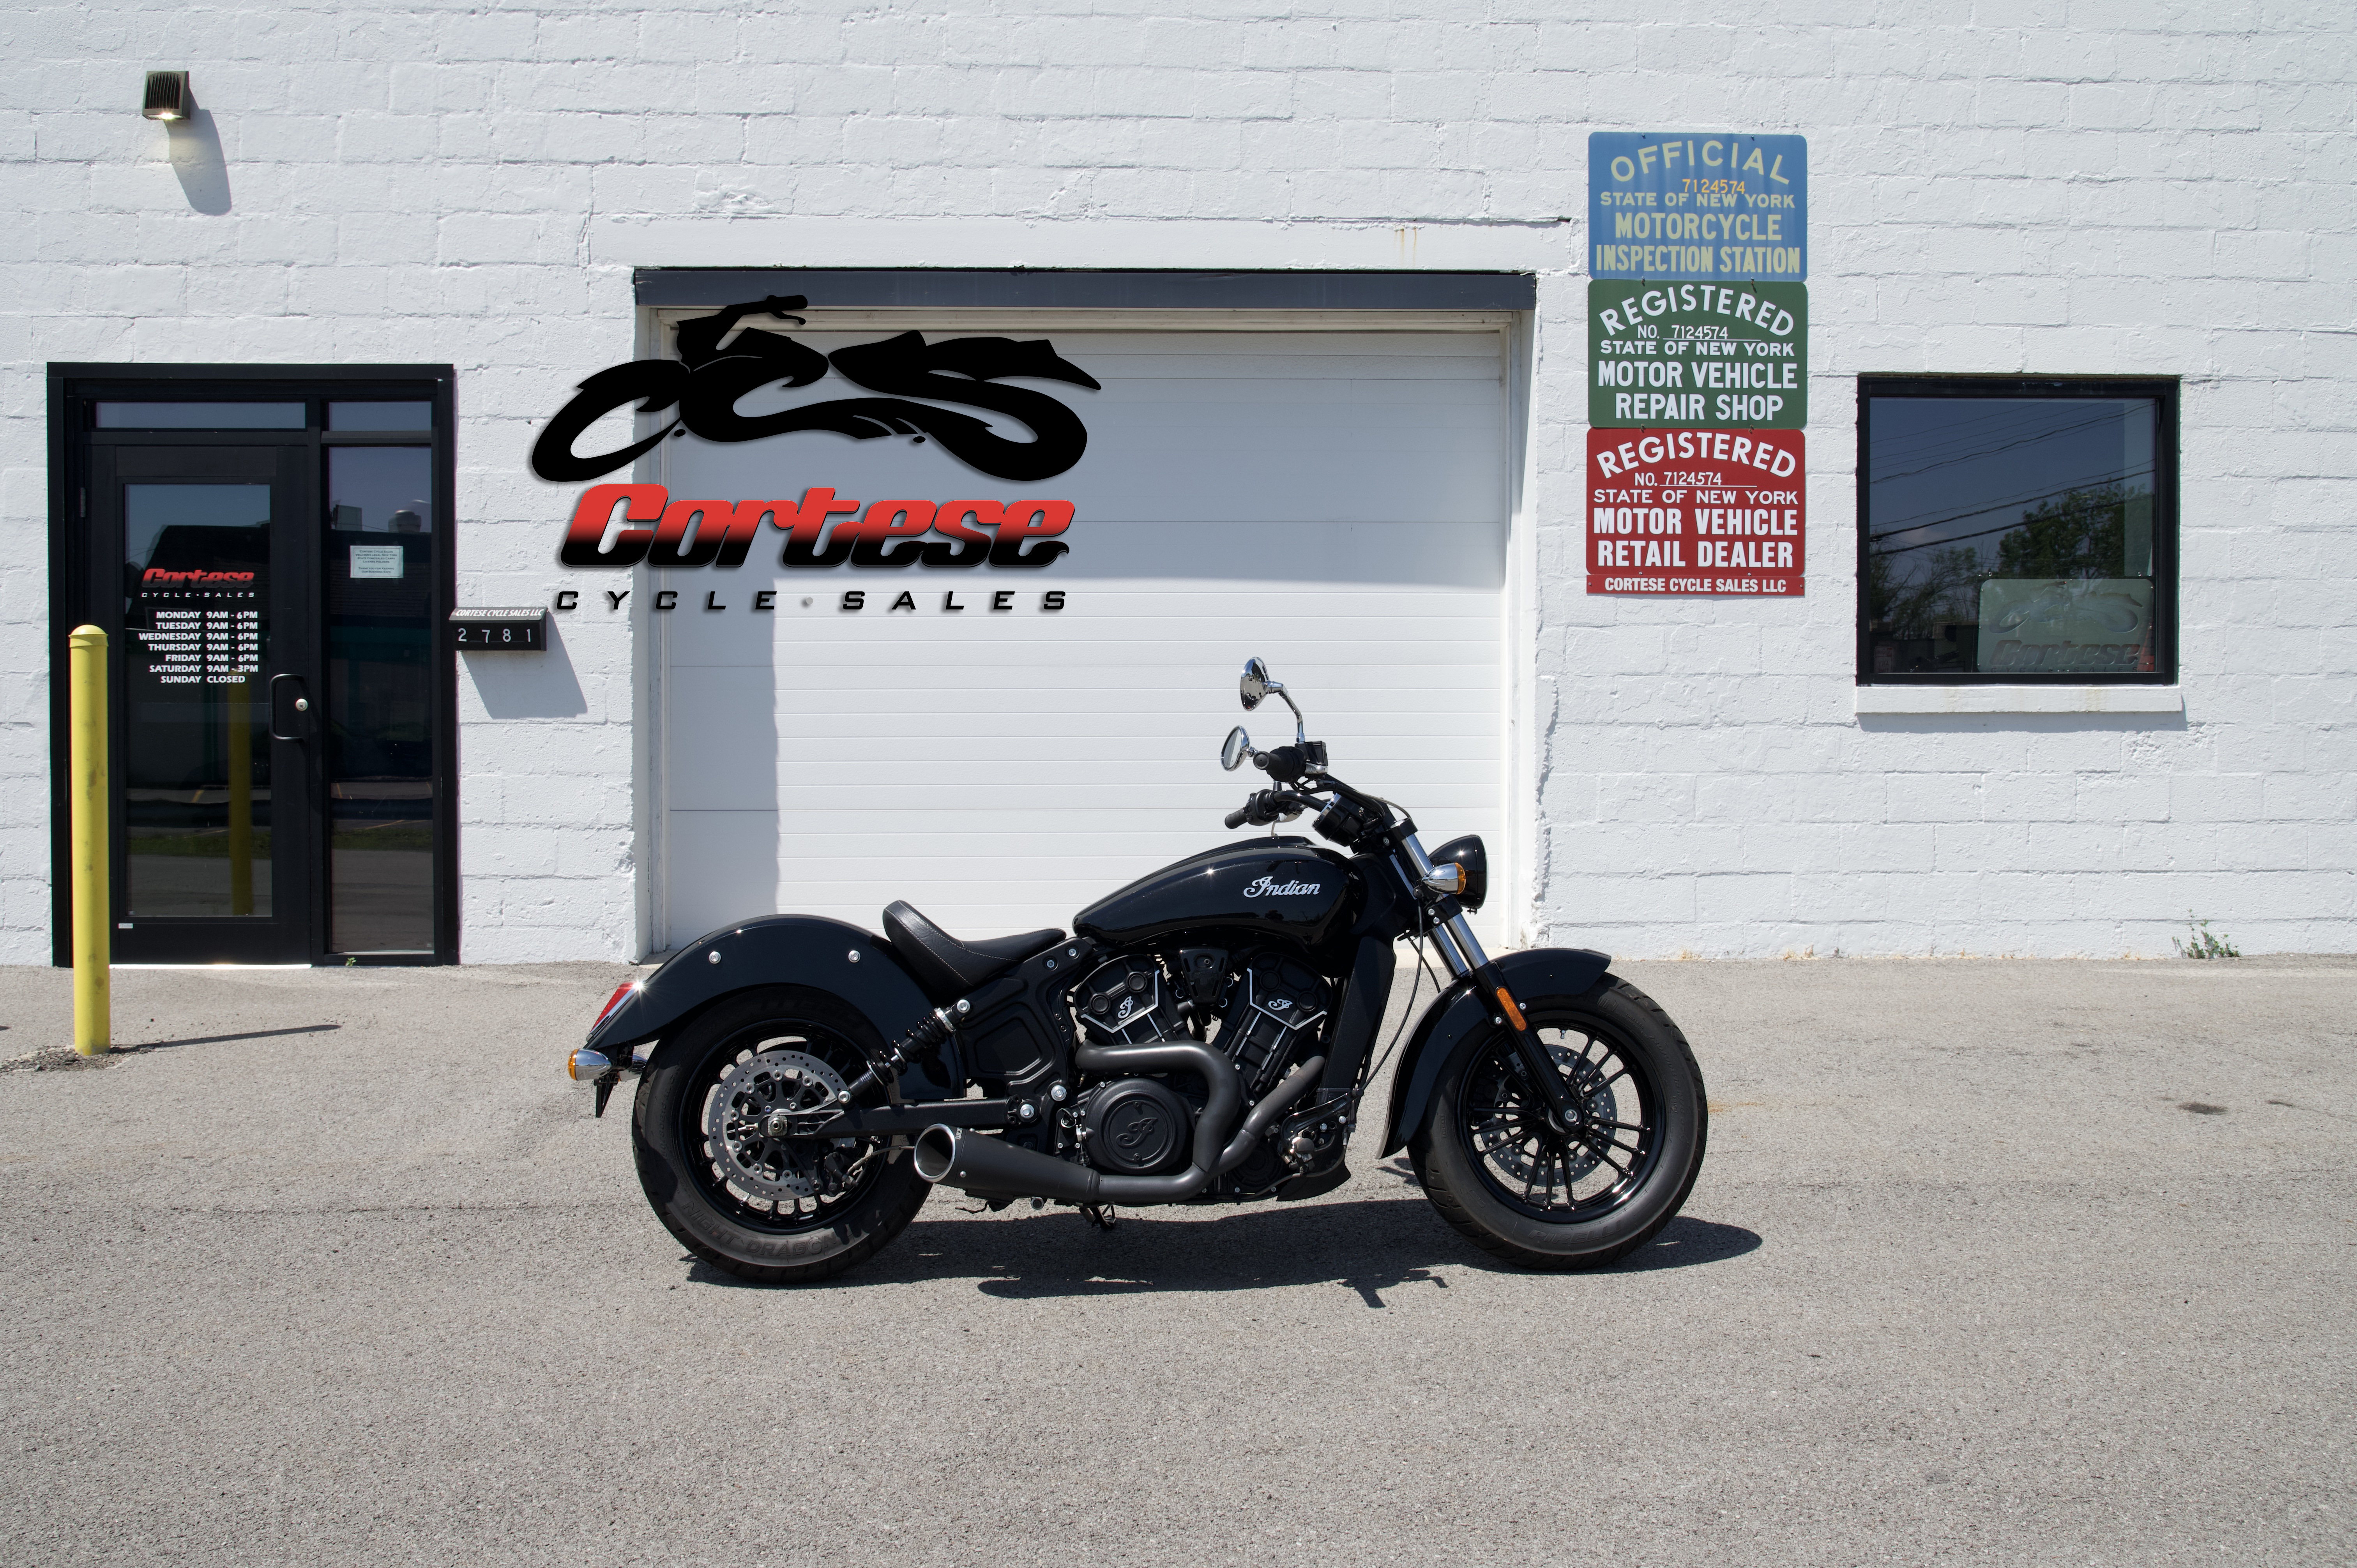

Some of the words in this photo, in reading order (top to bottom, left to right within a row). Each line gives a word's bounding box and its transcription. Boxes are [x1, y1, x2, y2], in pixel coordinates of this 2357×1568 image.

[1611, 140, 1790, 185] OFFICIAL
[1682, 179, 1745, 194] 7124574
[1600, 192, 1657, 206] STATE
[1664, 192, 1689, 207] OF
[1697, 193, 1738, 207] NEW
[1745, 194, 1795, 208] YORK
[1615, 212, 1782, 240] MOTORCYCLE
[1596, 244, 1713, 272] INSPECTION
[1720, 247, 1800, 273] STATION
[1599, 284, 1794, 336] REGISTERED
[1638, 325, 1660, 339] NO.
[1671, 325, 1728, 339] 7124574
[1600, 340, 1657, 354] STATE
[1664, 341, 1689, 355] OF
[1696, 342, 1737, 356] NEW
[1743, 343, 1795, 356] YORK
[1598, 360, 1683, 388] MOTOR
[1691, 362, 1797, 388] VEHICLE
[1616, 393, 1705, 420] REPAIR
[1715, 394, 1783, 420] SHOP
[1596, 432, 1796, 479] REGISTERED
[1634, 472, 1658, 486] NO.
[1664, 471, 1722, 486] 7124574
[1594, 489, 1653, 503] STATE
[1662, 490, 1687, 503] OF
[1697, 491, 1736, 504] NEW
[1745, 491, 1798, 505] YORK
[1594, 508, 1682, 534] MOTOR
[1695, 509, 1798, 536] VEHICLE
[1598, 540, 1686, 567] RETAIL
[1698, 541, 1793, 568] DEALER
[142, 568, 254, 588] Cortese
[1605, 577, 1665, 591] CORTESE
[1670, 578, 1712, 592] CYCLE
[1716, 579, 1758, 592] SALES
[1762, 579, 1786, 592] LLC
[1989, 640, 2140, 665] Cortese
[1243, 876, 1321, 898] Indian
[682, 1201, 741, 1245] NIGHT
[745, 1231, 837, 1255] DRAGON
[1527, 1219, 1622, 1244] PIRELLI
